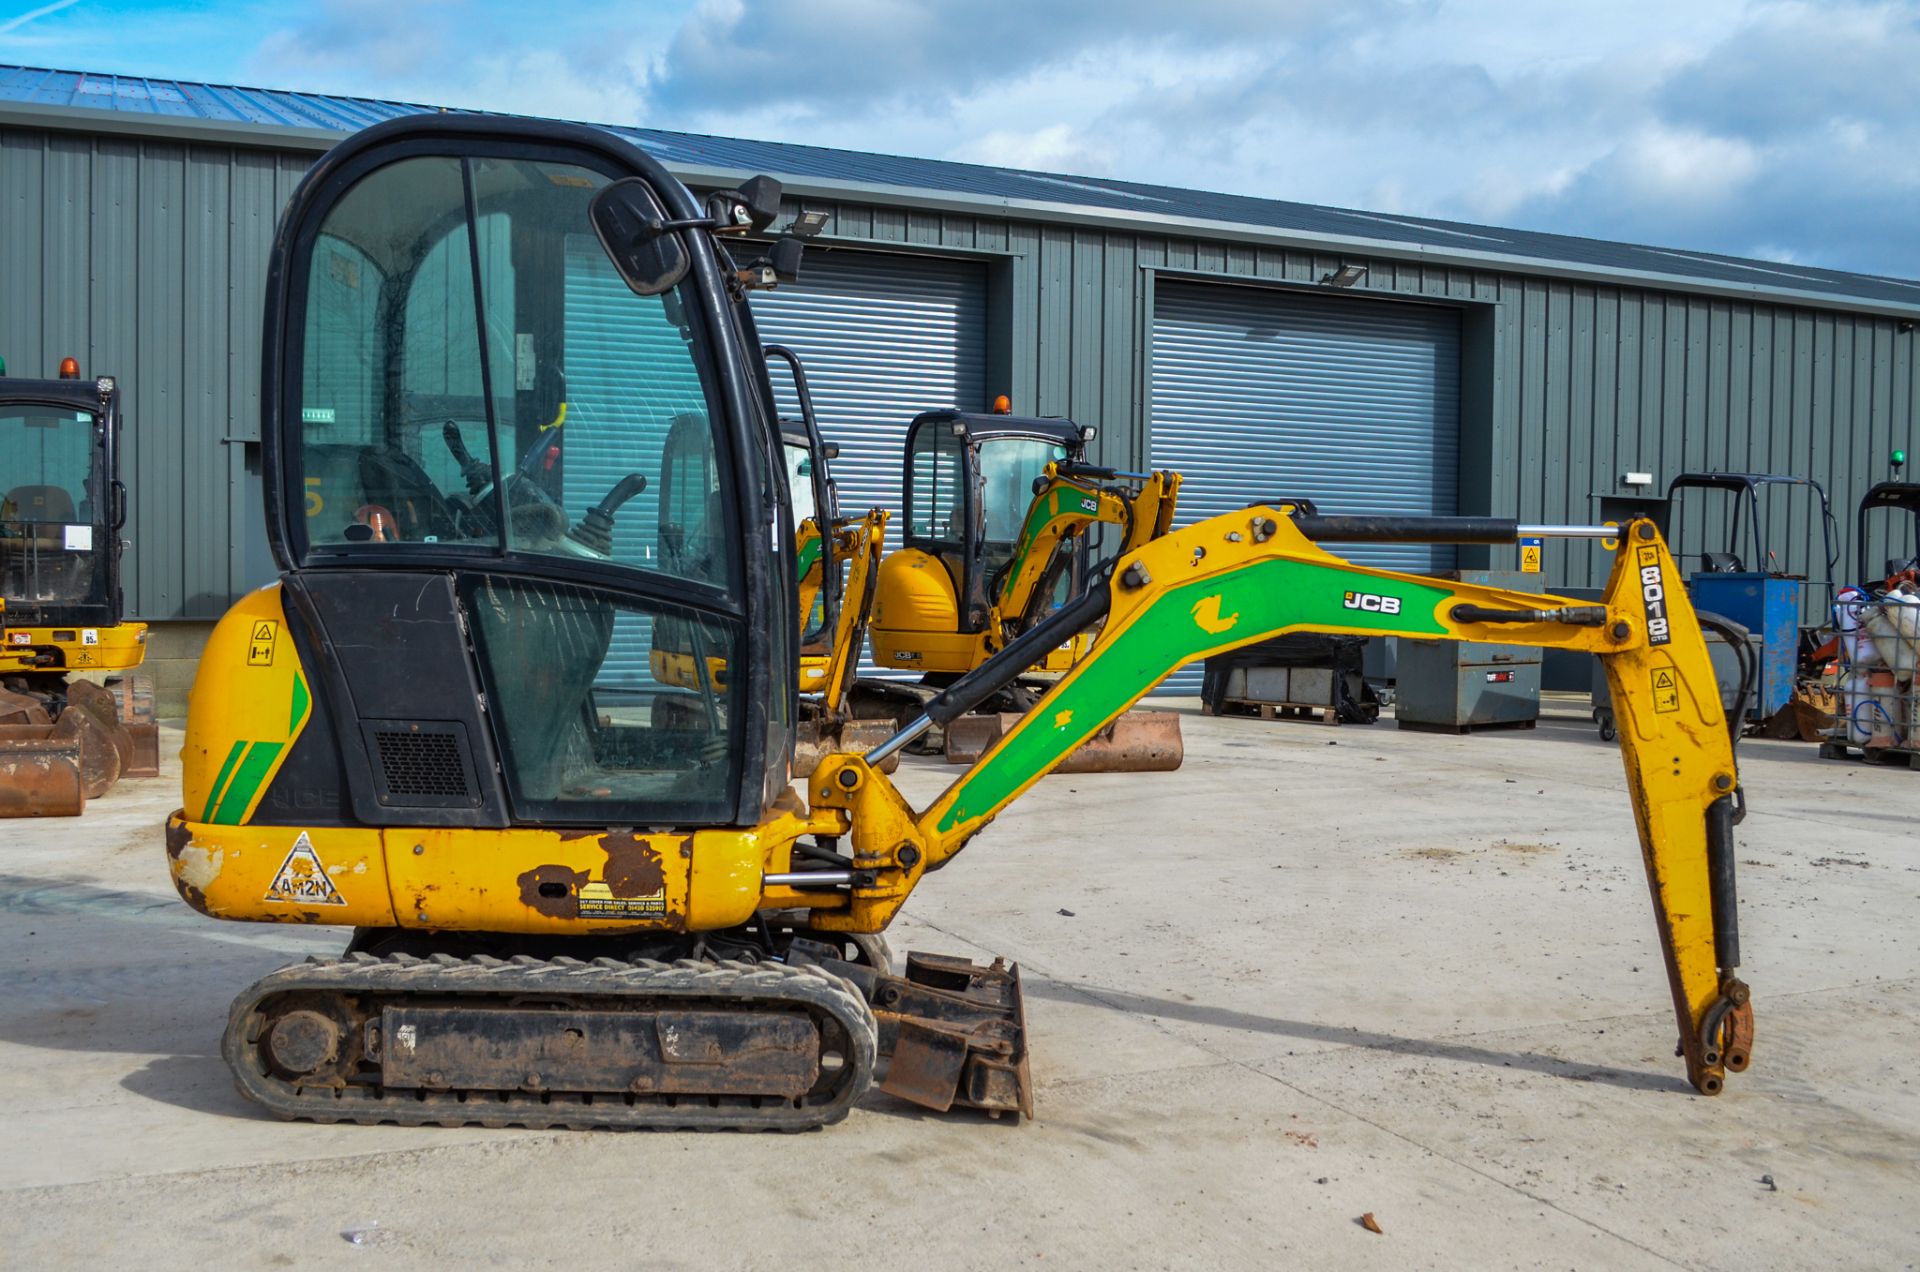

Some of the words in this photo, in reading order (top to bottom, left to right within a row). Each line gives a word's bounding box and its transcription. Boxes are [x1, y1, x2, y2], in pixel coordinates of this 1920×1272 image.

[1081, 497, 1097, 512] JCB
[1344, 593, 1400, 614] JCB
[1641, 566, 1668, 636] 8018
